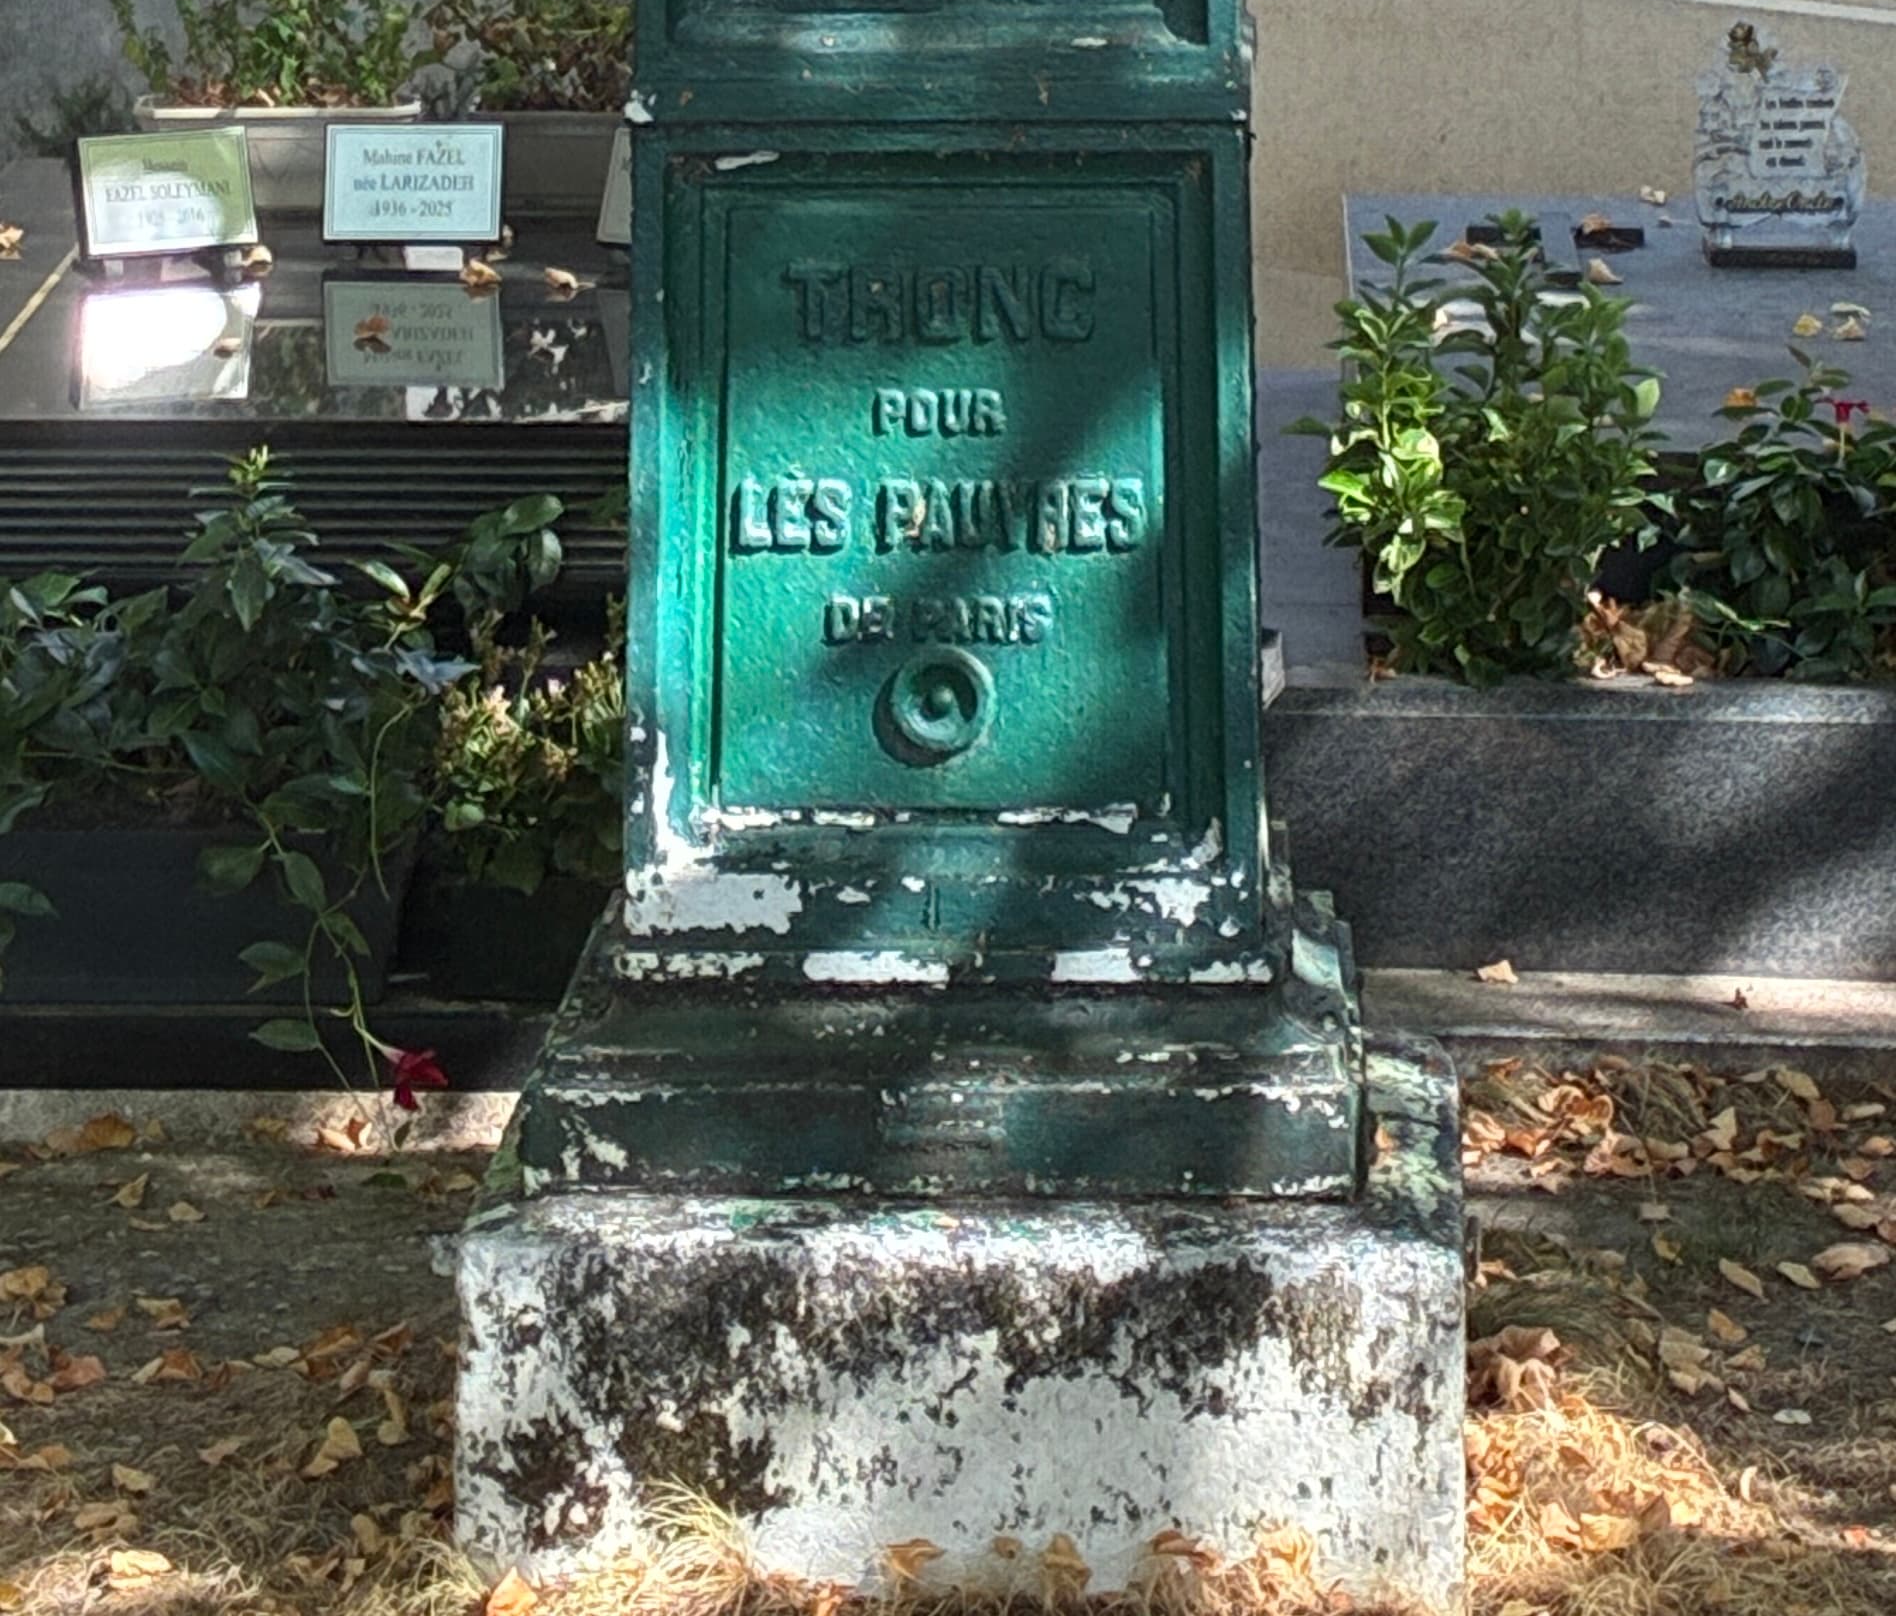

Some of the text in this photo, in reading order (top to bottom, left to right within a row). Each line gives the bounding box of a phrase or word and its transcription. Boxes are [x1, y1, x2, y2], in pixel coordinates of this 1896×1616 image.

[783, 261, 1095, 344] TRONC
[873, 387, 1005, 437] POUR
[731, 475, 1148, 553] LES PAUVRES
[824, 593, 1054, 645] DE PARIS
